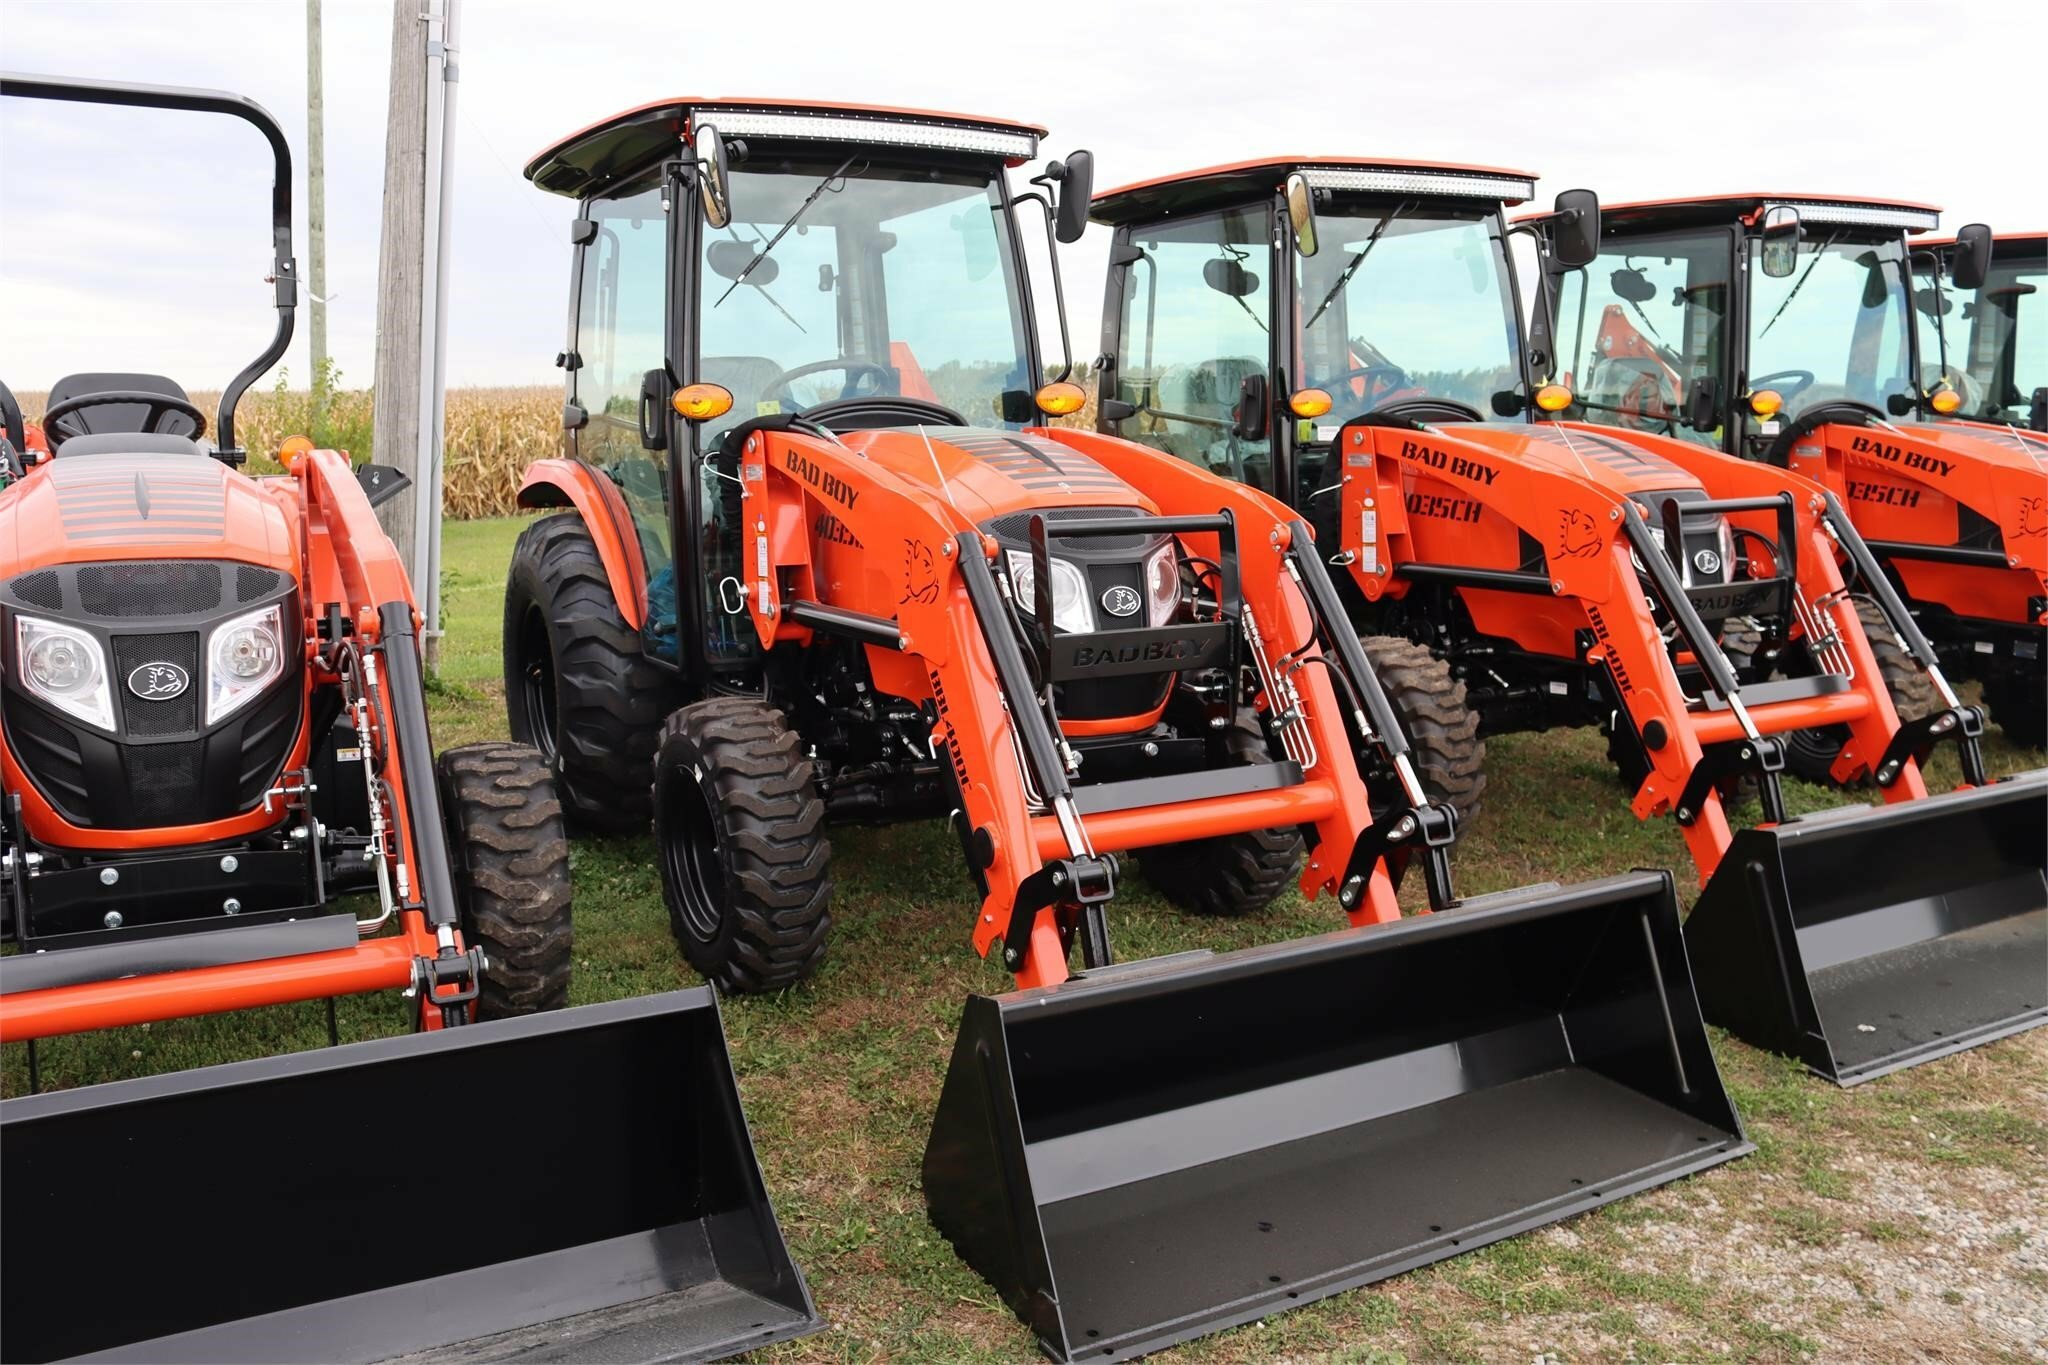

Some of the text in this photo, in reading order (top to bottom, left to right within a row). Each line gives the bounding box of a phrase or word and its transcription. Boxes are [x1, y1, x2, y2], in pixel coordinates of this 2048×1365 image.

[1401, 440, 1448, 470] BAD
[1450, 456, 1500, 486] BOY
[1851, 436, 1901, 462] BAD
[1904, 451, 1957, 477] BOY
[786, 448, 820, 487] BAD
[822, 471, 859, 511] BOY
[1404, 492, 1483, 523] 035CH
